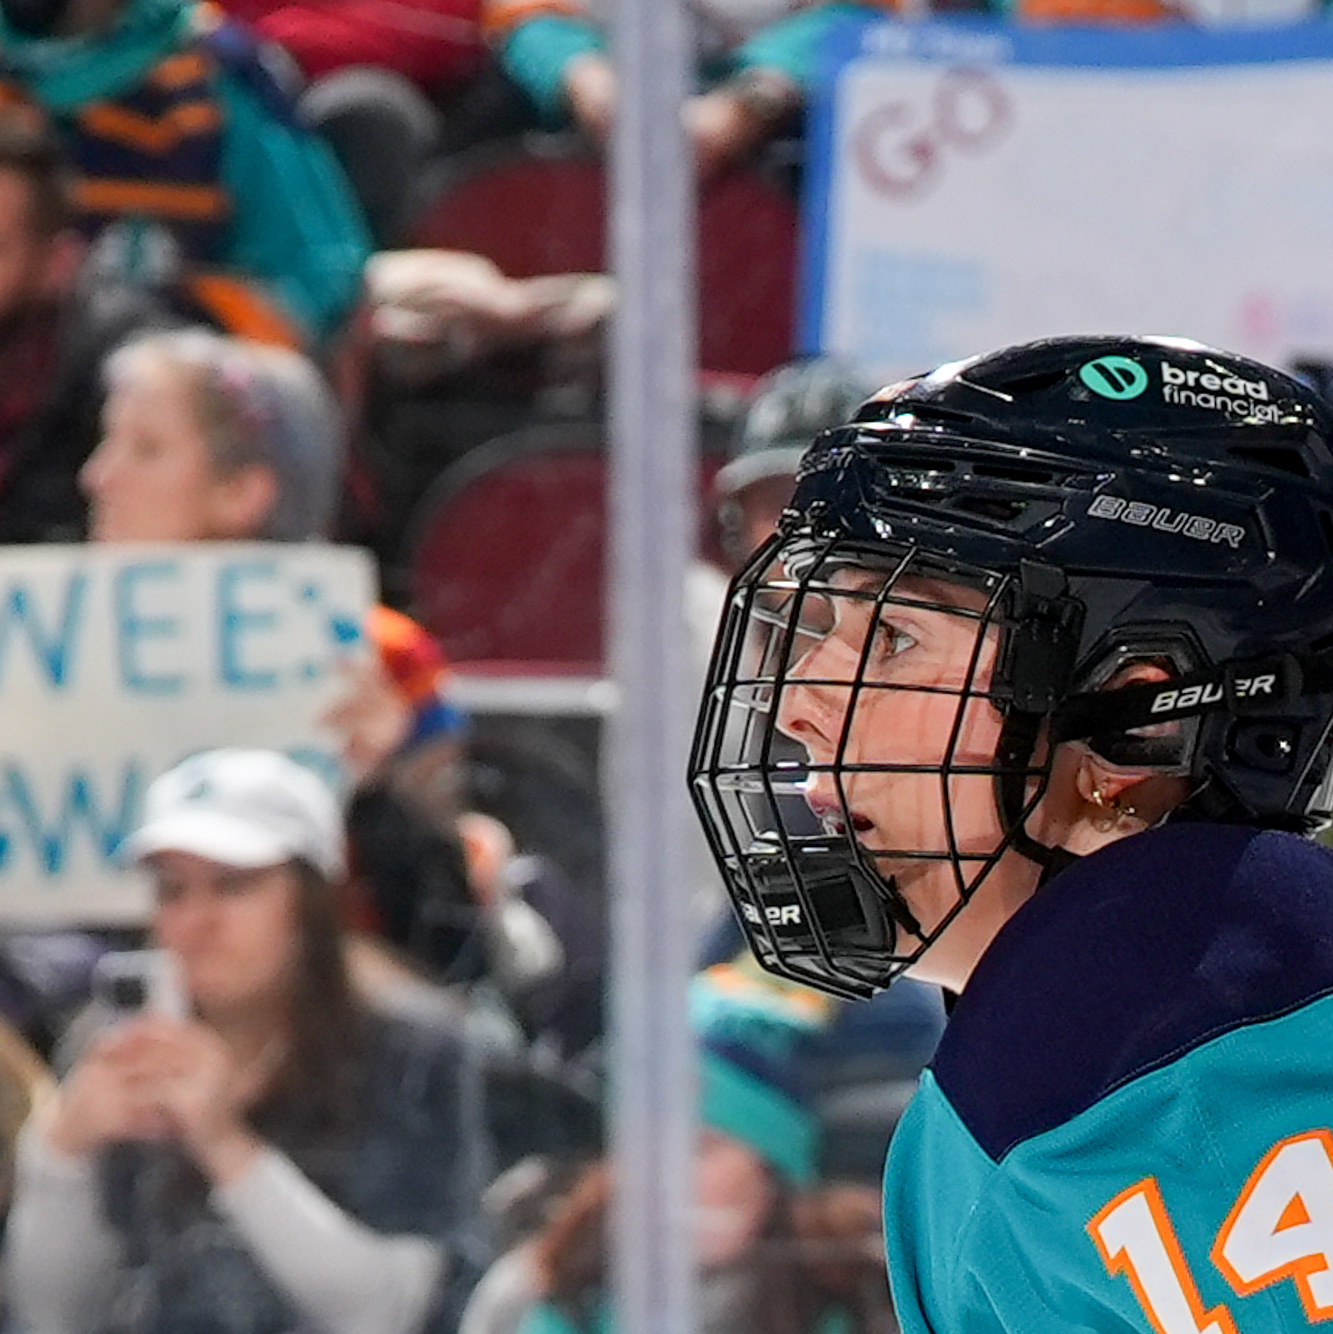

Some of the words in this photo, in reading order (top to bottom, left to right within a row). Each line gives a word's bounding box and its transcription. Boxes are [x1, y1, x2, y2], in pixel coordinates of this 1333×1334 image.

[853, 64, 1013, 200] GO
[1161, 362, 1269, 401] bread
[1087, 494, 1246, 548] BAUER
